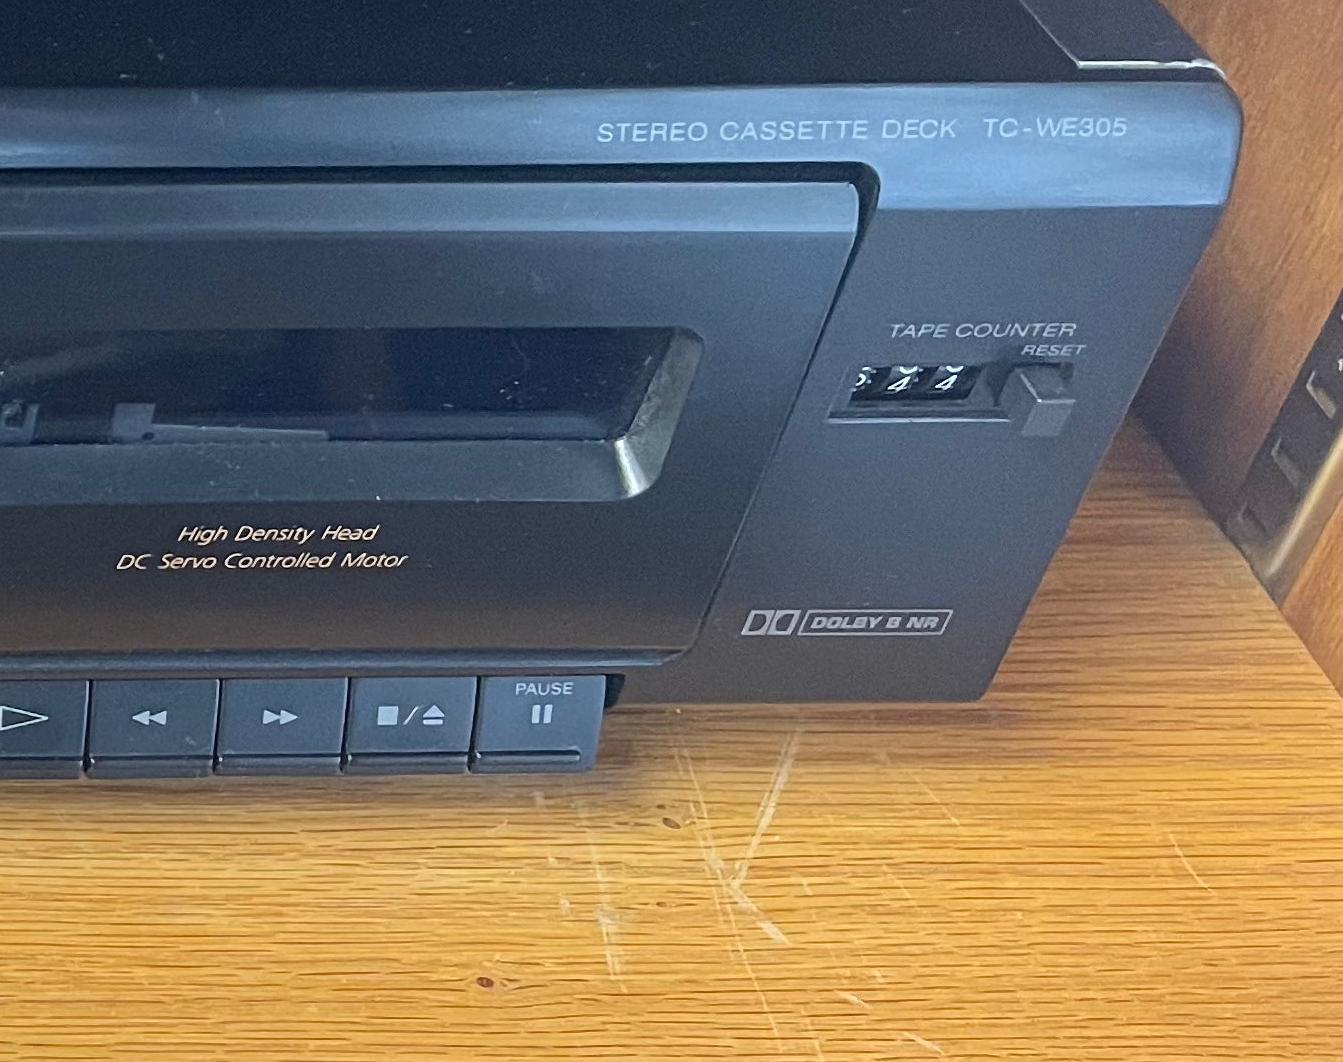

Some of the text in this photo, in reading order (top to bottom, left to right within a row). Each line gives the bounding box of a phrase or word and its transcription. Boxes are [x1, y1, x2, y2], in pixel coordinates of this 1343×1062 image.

[597, 117, 1128, 142] STEREO CASSETTE DECK TC-WE305
[890, 322, 1077, 338] TAPE COUNTER
[1021, 344, 1087, 356] RESET
[177, 524, 380, 545] High Density Head
[116, 552, 409, 570] DC Servo Controlled Motor
[810, 616, 940, 629] DOLBY B NR
[515, 682, 574, 696] PAUSE
